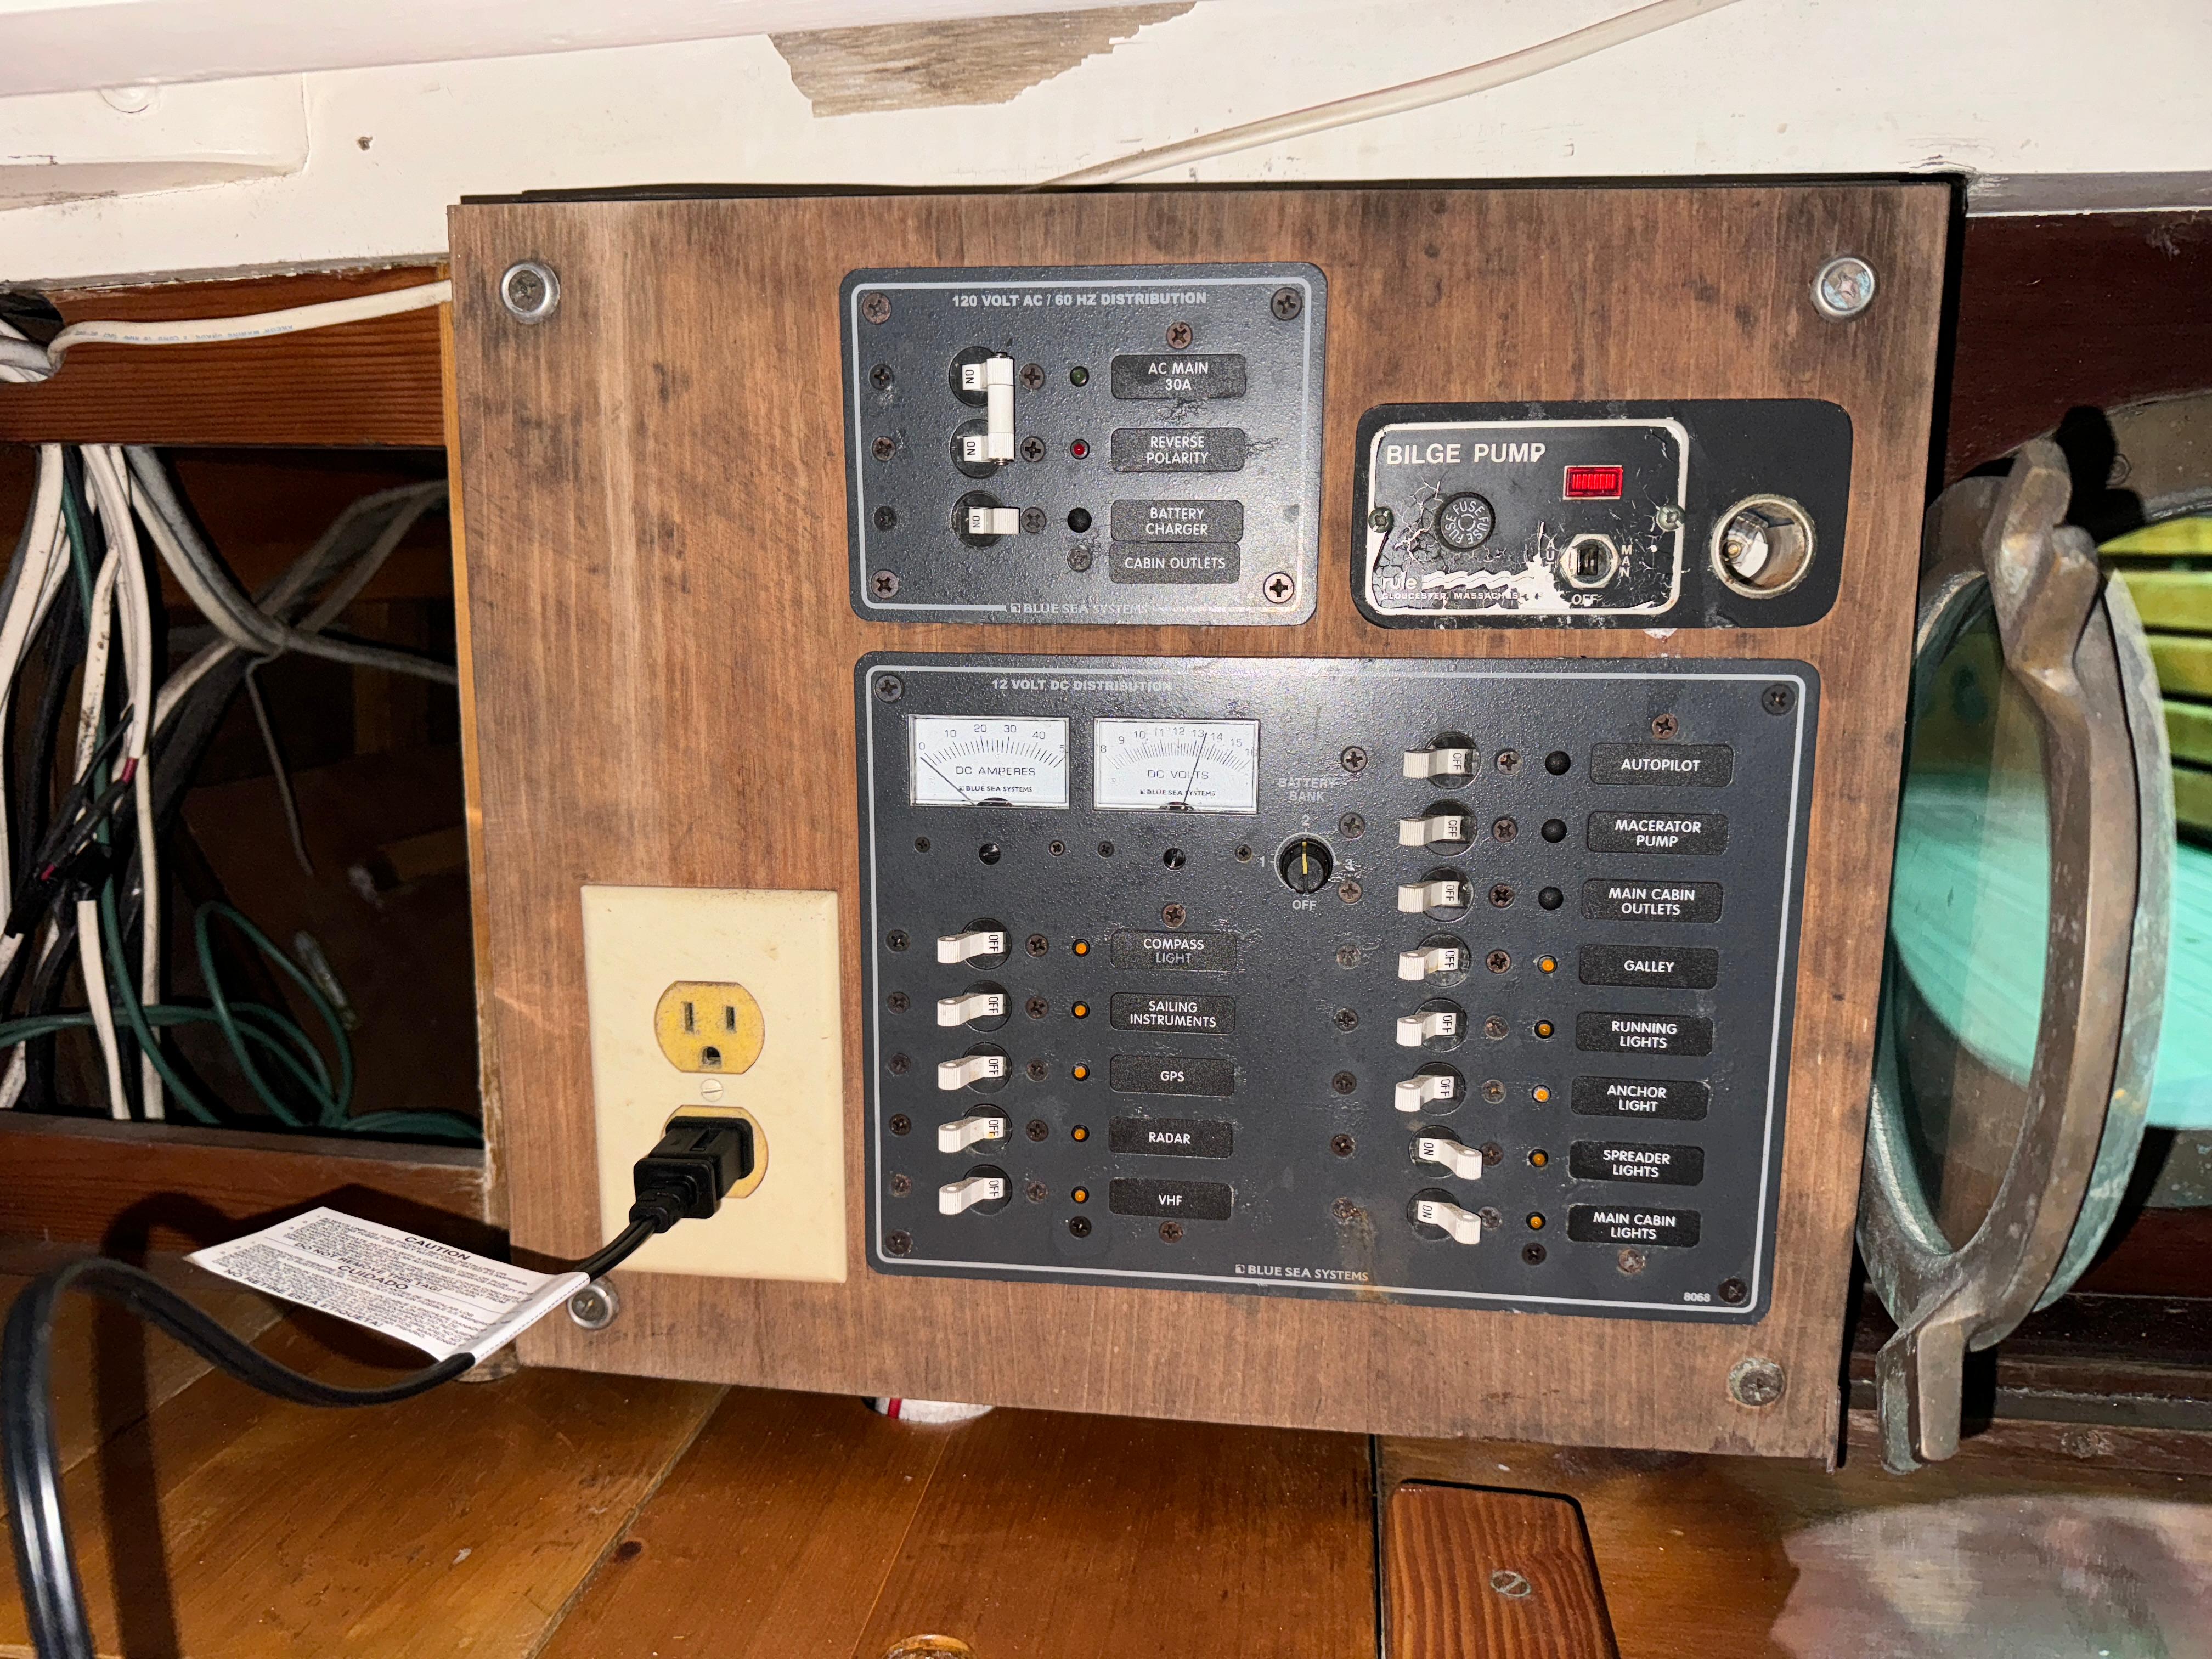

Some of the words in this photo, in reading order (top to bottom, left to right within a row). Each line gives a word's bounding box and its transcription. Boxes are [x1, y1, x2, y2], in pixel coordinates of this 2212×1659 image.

[952, 296, 977, 307] 120
[983, 296, 1019, 307] VOLT
[1023, 295, 1042, 306] AC
[1055, 295, 1073, 306] 60
[1076, 294, 1096, 305] HZ
[1101, 292, 1206, 304] DISTRIBUTION
[1148, 363, 1168, 374] AC
[1172, 362, 1208, 374] MAIN
[965, 369, 974, 383] ON
[1165, 379, 1191, 391] 30A
[967, 441, 975, 455] ON
[1150, 436, 1205, 448] REVERSE
[1147, 452, 1209, 464] POLARITY
[1387, 443, 1460, 464] BILGE
[1474, 443, 1547, 463] PUMP
[1150, 508, 1205, 519] BATTERY
[1453, 501, 1485, 516] FUSE
[972, 515, 981, 528] ON
[1146, 523, 1207, 535] CHARGER
[1445, 514, 1464, 544] FUSE
[1466, 517, 1489, 544] FUSE
[1125, 558, 1165, 569] CABIN
[1170, 557, 1226, 569] OUTLETS
[1545, 540, 1555, 582] AUT
[1621, 545, 1632, 577] MAN
[1383, 571, 1417, 590] rule
[1571, 594, 1598, 605] OFF
[1024, 604, 1060, 613] BLUE
[1063, 604, 1088, 613] SEA
[992, 680, 1007, 690] 12
[1011, 680, 1046, 690] VOLT
[1051, 680, 1069, 690] DC
[1072, 680, 1173, 691] DISTRIBUTION
[1192, 729, 1204, 737] 13
[1453, 753, 1462, 770] OFF
[1621, 758, 1700, 771] AUTOPILOT
[956, 766, 972, 775] DC
[979, 767, 1035, 775] AMPERES
[1171, 771, 1209, 779] VOLTS
[1279, 778, 1335, 788] BATTERY
[1290, 792, 1325, 802] BANK
[1302, 815, 1309, 826] 2
[1615, 820, 1701, 833] MACERATOR
[1448, 820, 1457, 837] OFF
[1636, 835, 1678, 847] PUMP
[1261, 856, 1265, 867] 1
[1345, 859, 1354, 871] 3
[1609, 888, 1646, 899] MAIN
[1651, 889, 1695, 901] CABIN
[1293, 900, 1317, 910] OFF
[1622, 903, 1680, 915] OUTLETS
[989, 934, 998, 952] OFF
[1143, 939, 1204, 950] COMPASS
[1156, 952, 1192, 963] LIGHT
[1445, 951, 1455, 969] OFF
[1624, 960, 1674, 972] GALLEY
[989, 997, 998, 1013] OFF
[1149, 1001, 1197, 1012] SAILING
[1130, 1014, 1216, 1028] INSTRUMENTS
[1443, 1015, 1452, 1034] OFF
[1612, 1021, 1677, 1035] RUNNING
[1620, 1036, 1667, 1048] LIGHTS
[989, 1058, 998, 1076] OFF
[1160, 1071, 1184, 1082] GPS
[1441, 1079, 1450, 1097] OFF
[1607, 1085, 1666, 1098] ANCHOR
[1619, 1099, 1658, 1112] LIGHT
[989, 1120, 998, 1136] OFF
[1149, 1132, 1190, 1144] RADAR
[1424, 1143, 1434, 1155] ON
[1603, 1150, 1670, 1164] SPREADER
[1613, 1164, 1660, 1178] LIGHTS
[989, 1180, 998, 1197] OFF
[1159, 1195, 1182, 1206] VHF
[1423, 1205, 1432, 1218] ON
[1593, 1212, 1629, 1224] MAIN
[1634, 1214, 1675, 1227] CABIN
[1611, 1227, 1657, 1240] LIGHTS
[405, 1236, 471, 1261] CAUTION
[314, 1248, 337, 1258] NOT
[338, 1257, 384, 1275] REMOVE
[387, 1271, 411, 1283] THIS
[415, 1280, 442, 1292] TAG!
[1248, 1265, 1282, 1276] BLUE
[1285, 1267, 1312, 1278] SEA
[1314, 1269, 1369, 1282] SYSTEMS
[338, 1265, 409, 1290] CUIDADO
[1684, 1292, 1711, 1302] 8068
